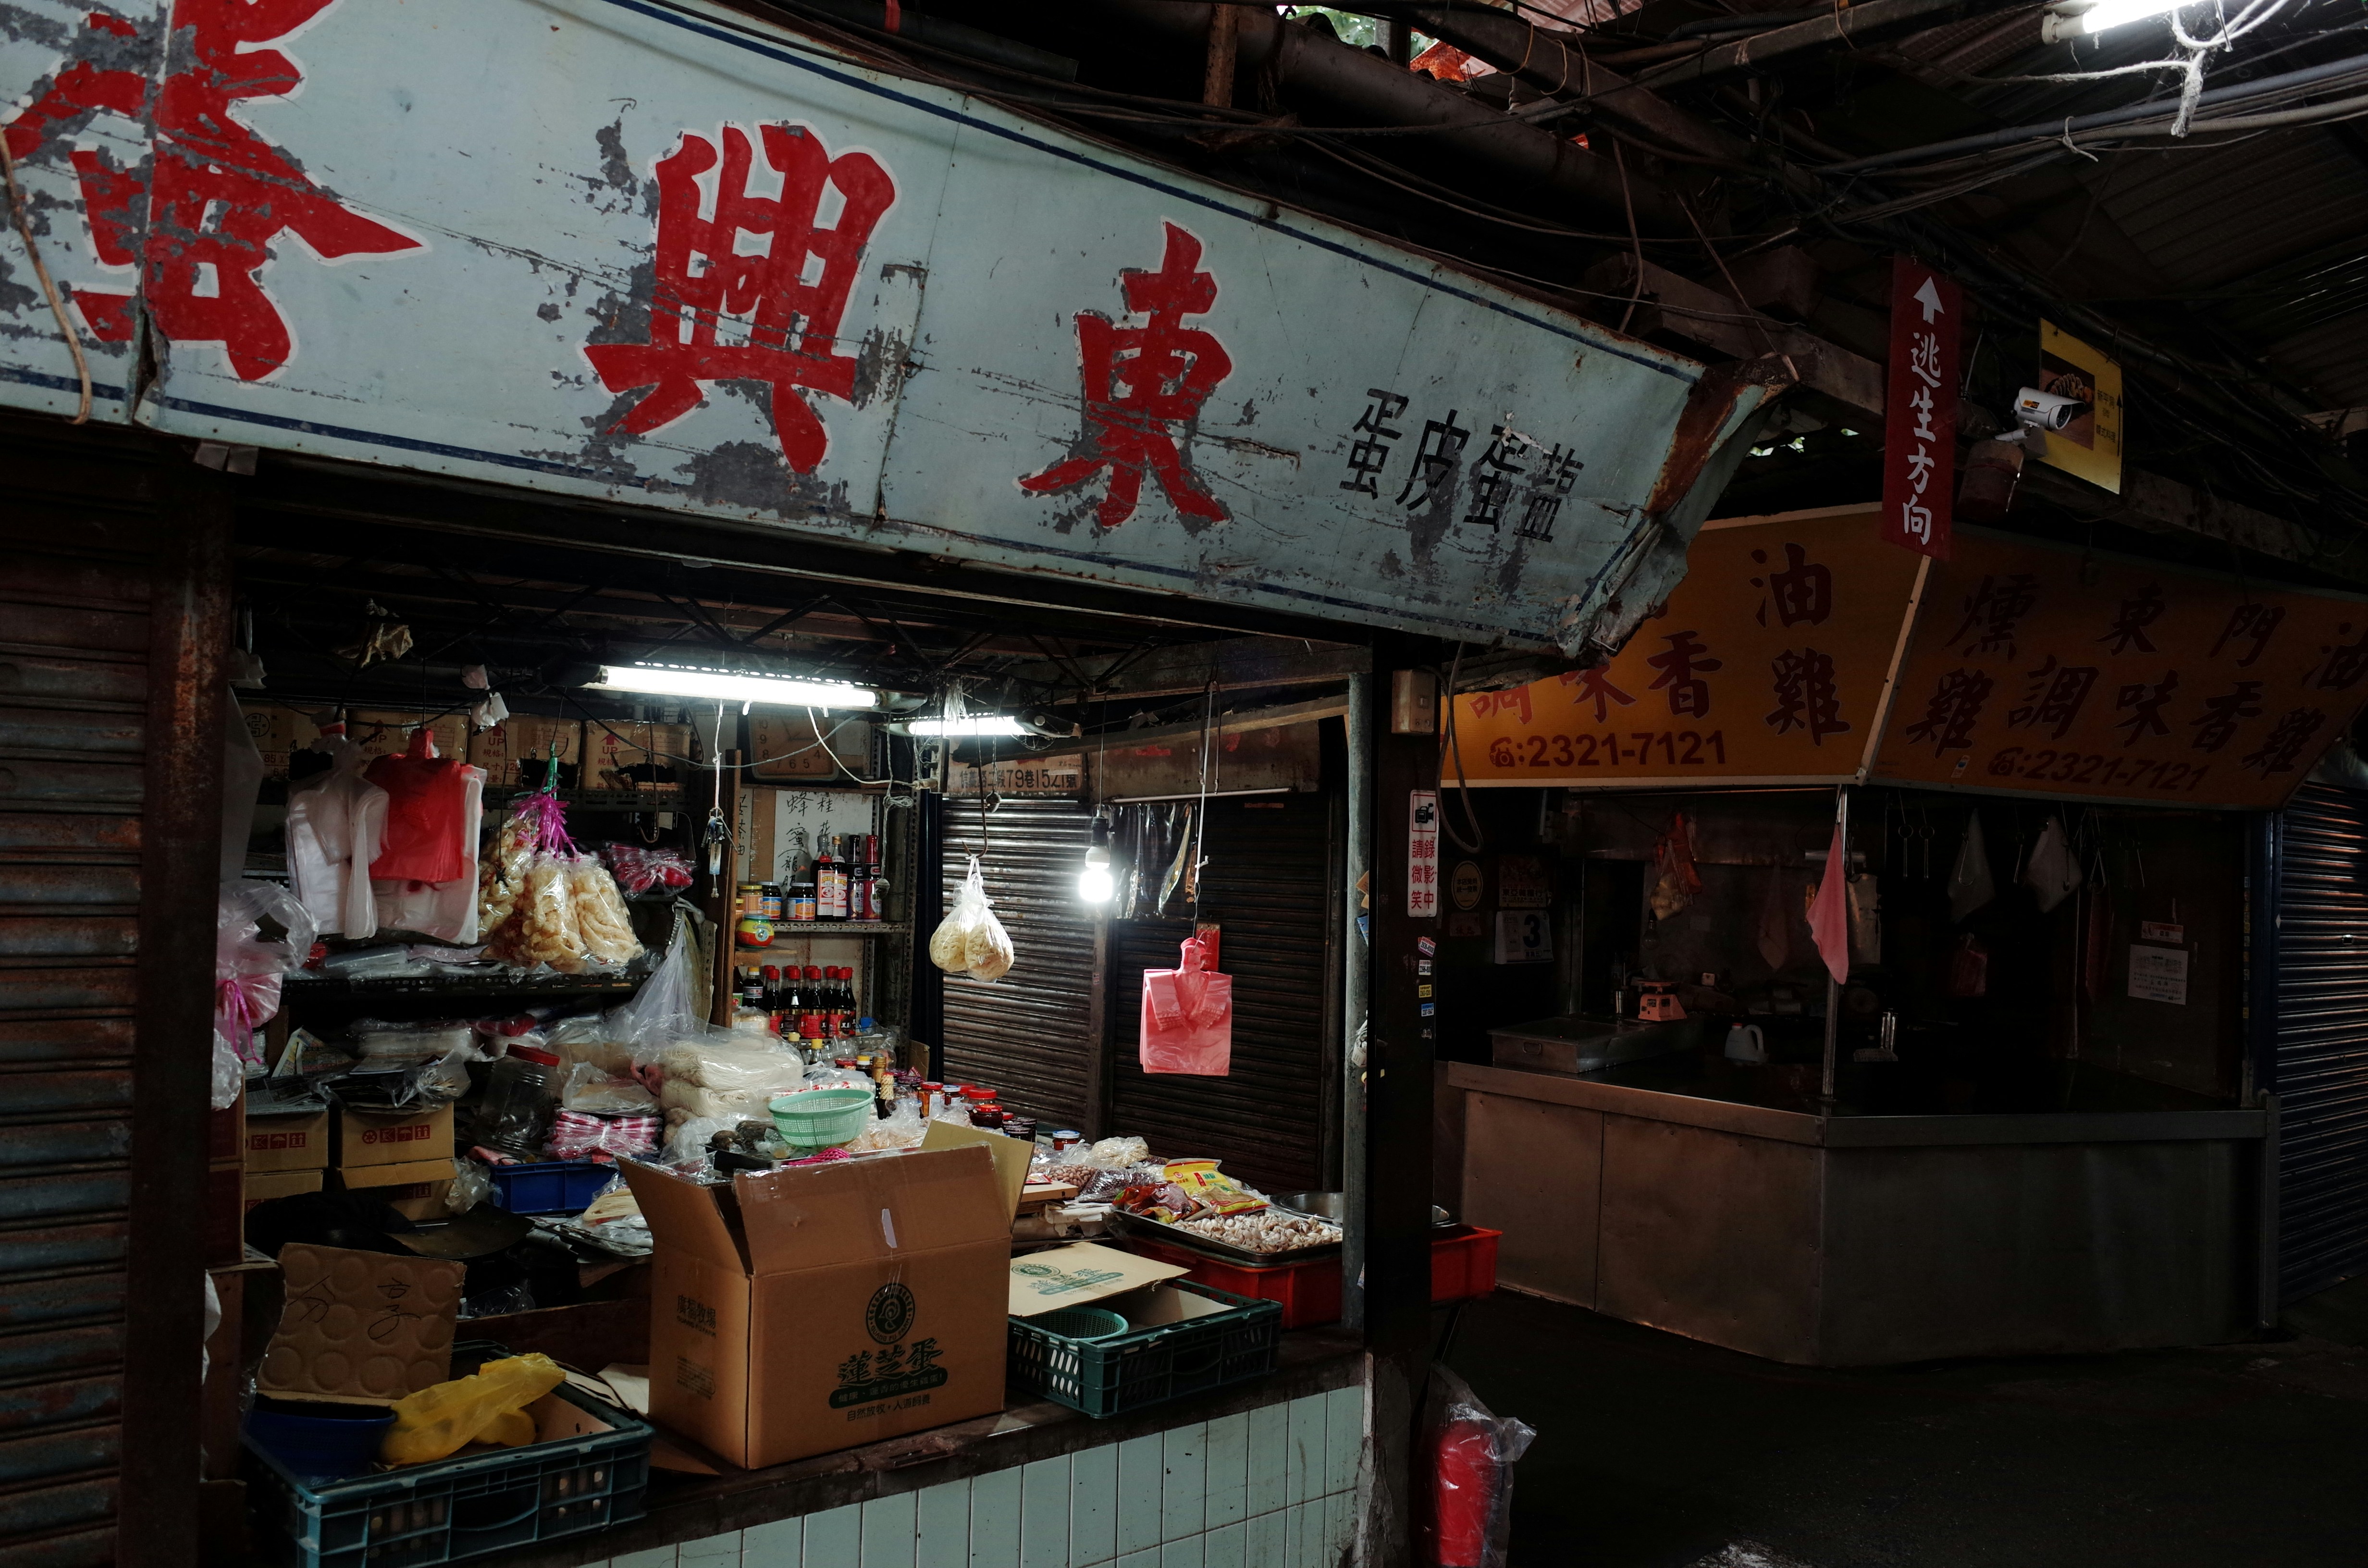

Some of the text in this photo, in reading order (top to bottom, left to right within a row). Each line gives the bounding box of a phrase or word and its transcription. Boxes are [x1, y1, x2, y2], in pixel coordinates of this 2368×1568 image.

[1901, 331, 1942, 546] 逃生方向
[2096, 581, 2287, 668] 東門
[1750, 542, 1851, 747] 油雞
[2008, 653, 2265, 754] 調味香
[488, 737, 504, 746] UP
[759, 734, 767, 744] 9
[762, 749, 769, 759] 8
[814, 749, 821, 760] 4
[789, 759, 796, 769] 6
[803, 759, 810, 769] 5
[1411, 839, 1423, 909] 請微笑
[1424, 840, 1435, 909] 錄影中
[1522, 914, 1541, 948] 3
[677, 1294, 716, 1329] 廣福牧場
[870, 1325, 887, 1342] GUANG
[898, 1319, 911, 1336] FARM
[838, 1337, 944, 1388] 蓮芝蛋
